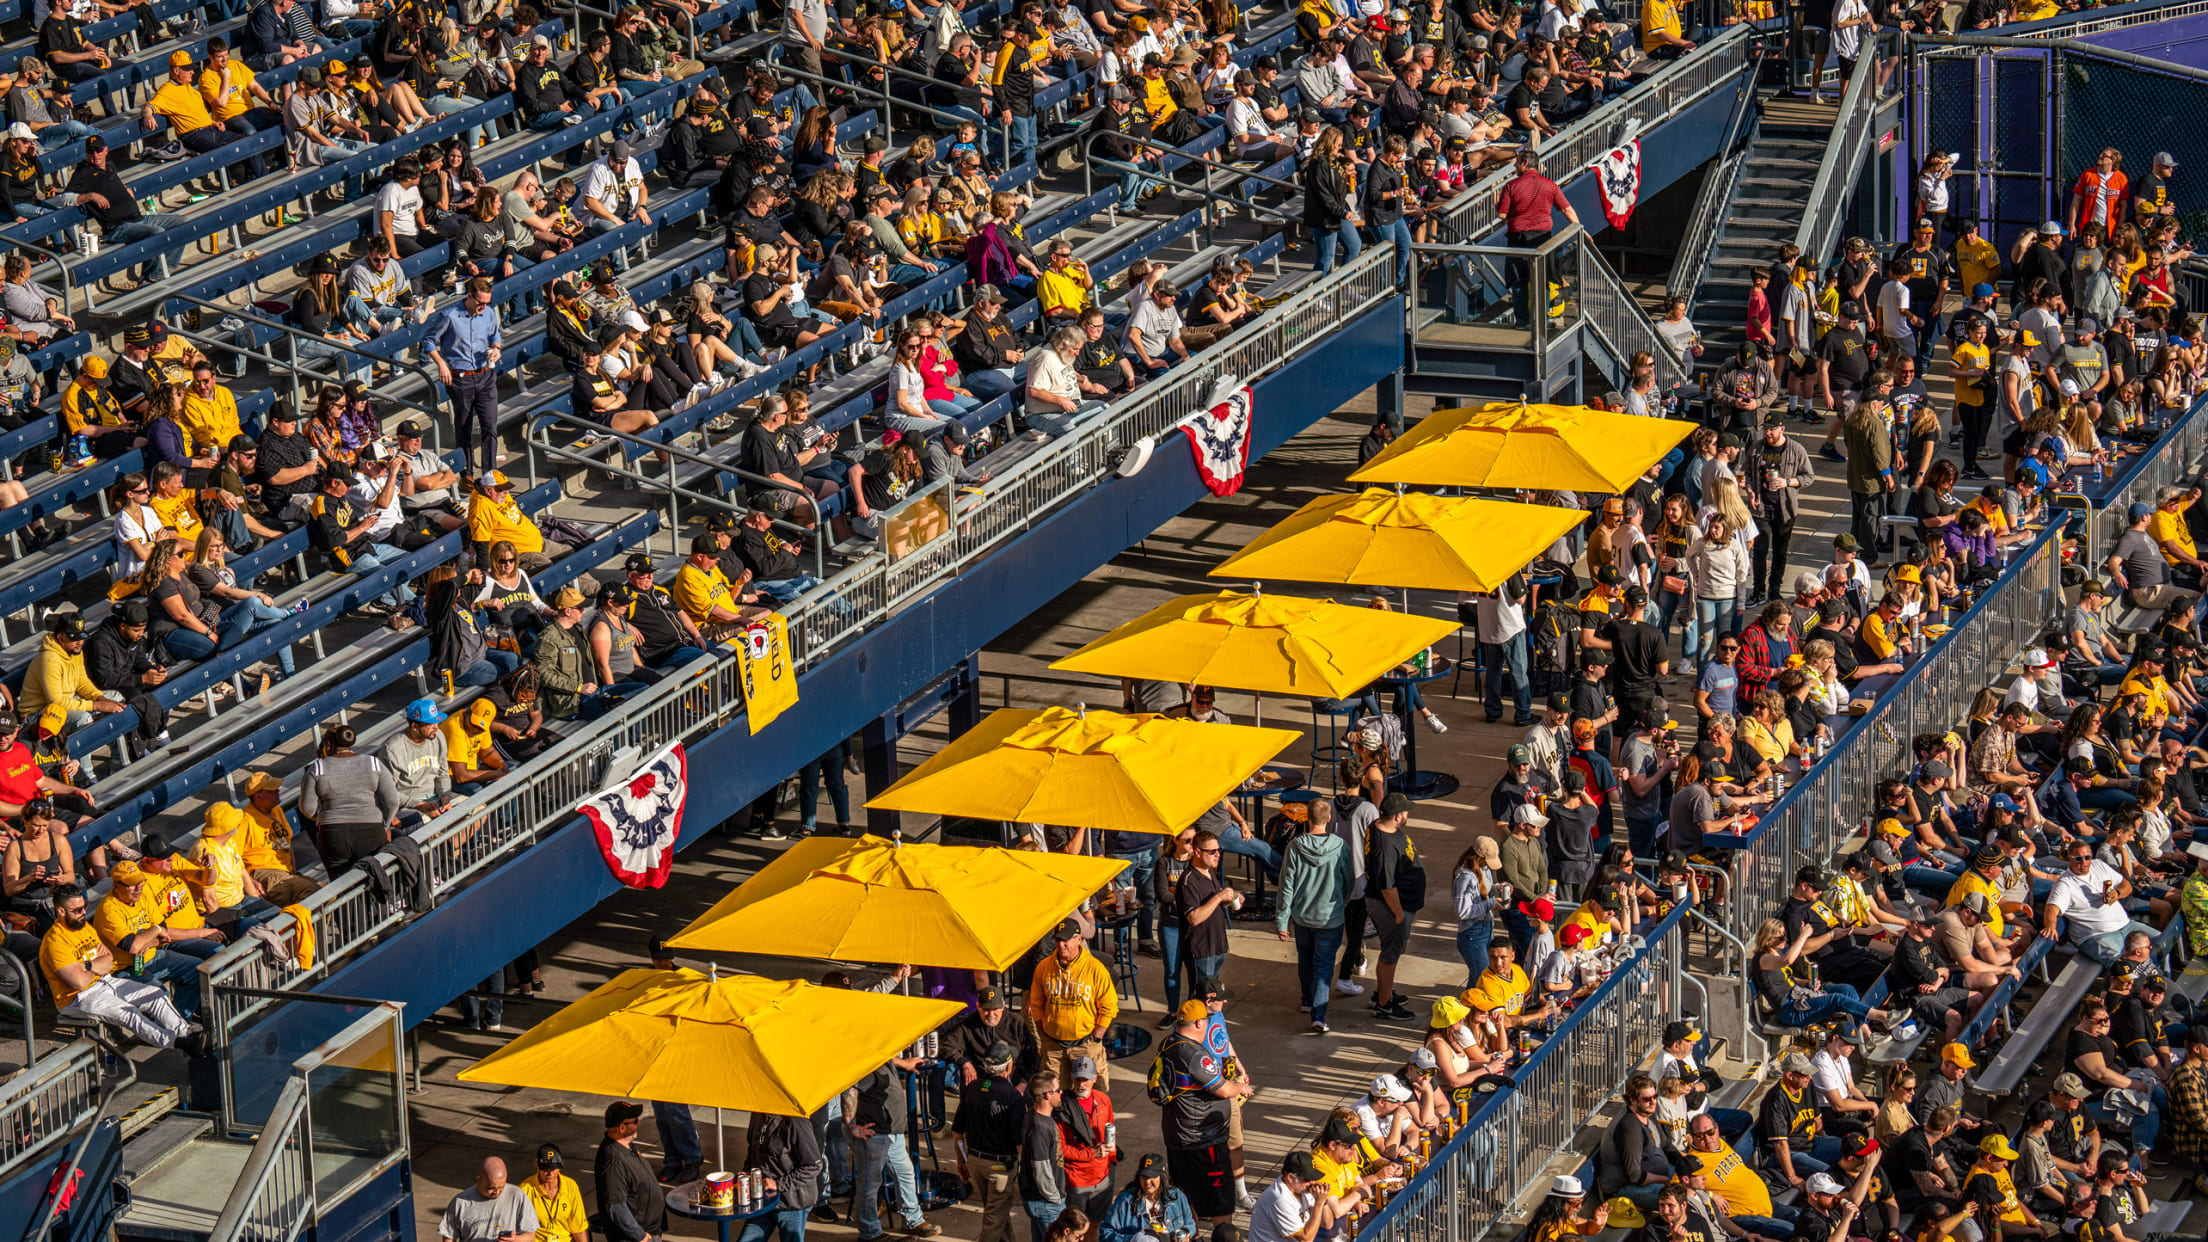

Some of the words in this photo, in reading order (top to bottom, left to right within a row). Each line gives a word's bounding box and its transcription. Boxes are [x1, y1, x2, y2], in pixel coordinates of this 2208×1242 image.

[710, 120, 724, 132] 22
[2081, 255, 2093, 270] P
[147, 368, 158, 381] P
[1562, 696, 1567, 705] P
[1611, 892, 1617, 901] P
[1059, 923, 1065, 933] P
[989, 992, 995, 1000] P
[1228, 1063, 1236, 1076] P
[2071, 1112, 2084, 1141] P
[1858, 1135, 1866, 1146] P
[548, 1151, 554, 1160] P
[1144, 1159, 1152, 1168] P
[1868, 1176, 1881, 1202] P
